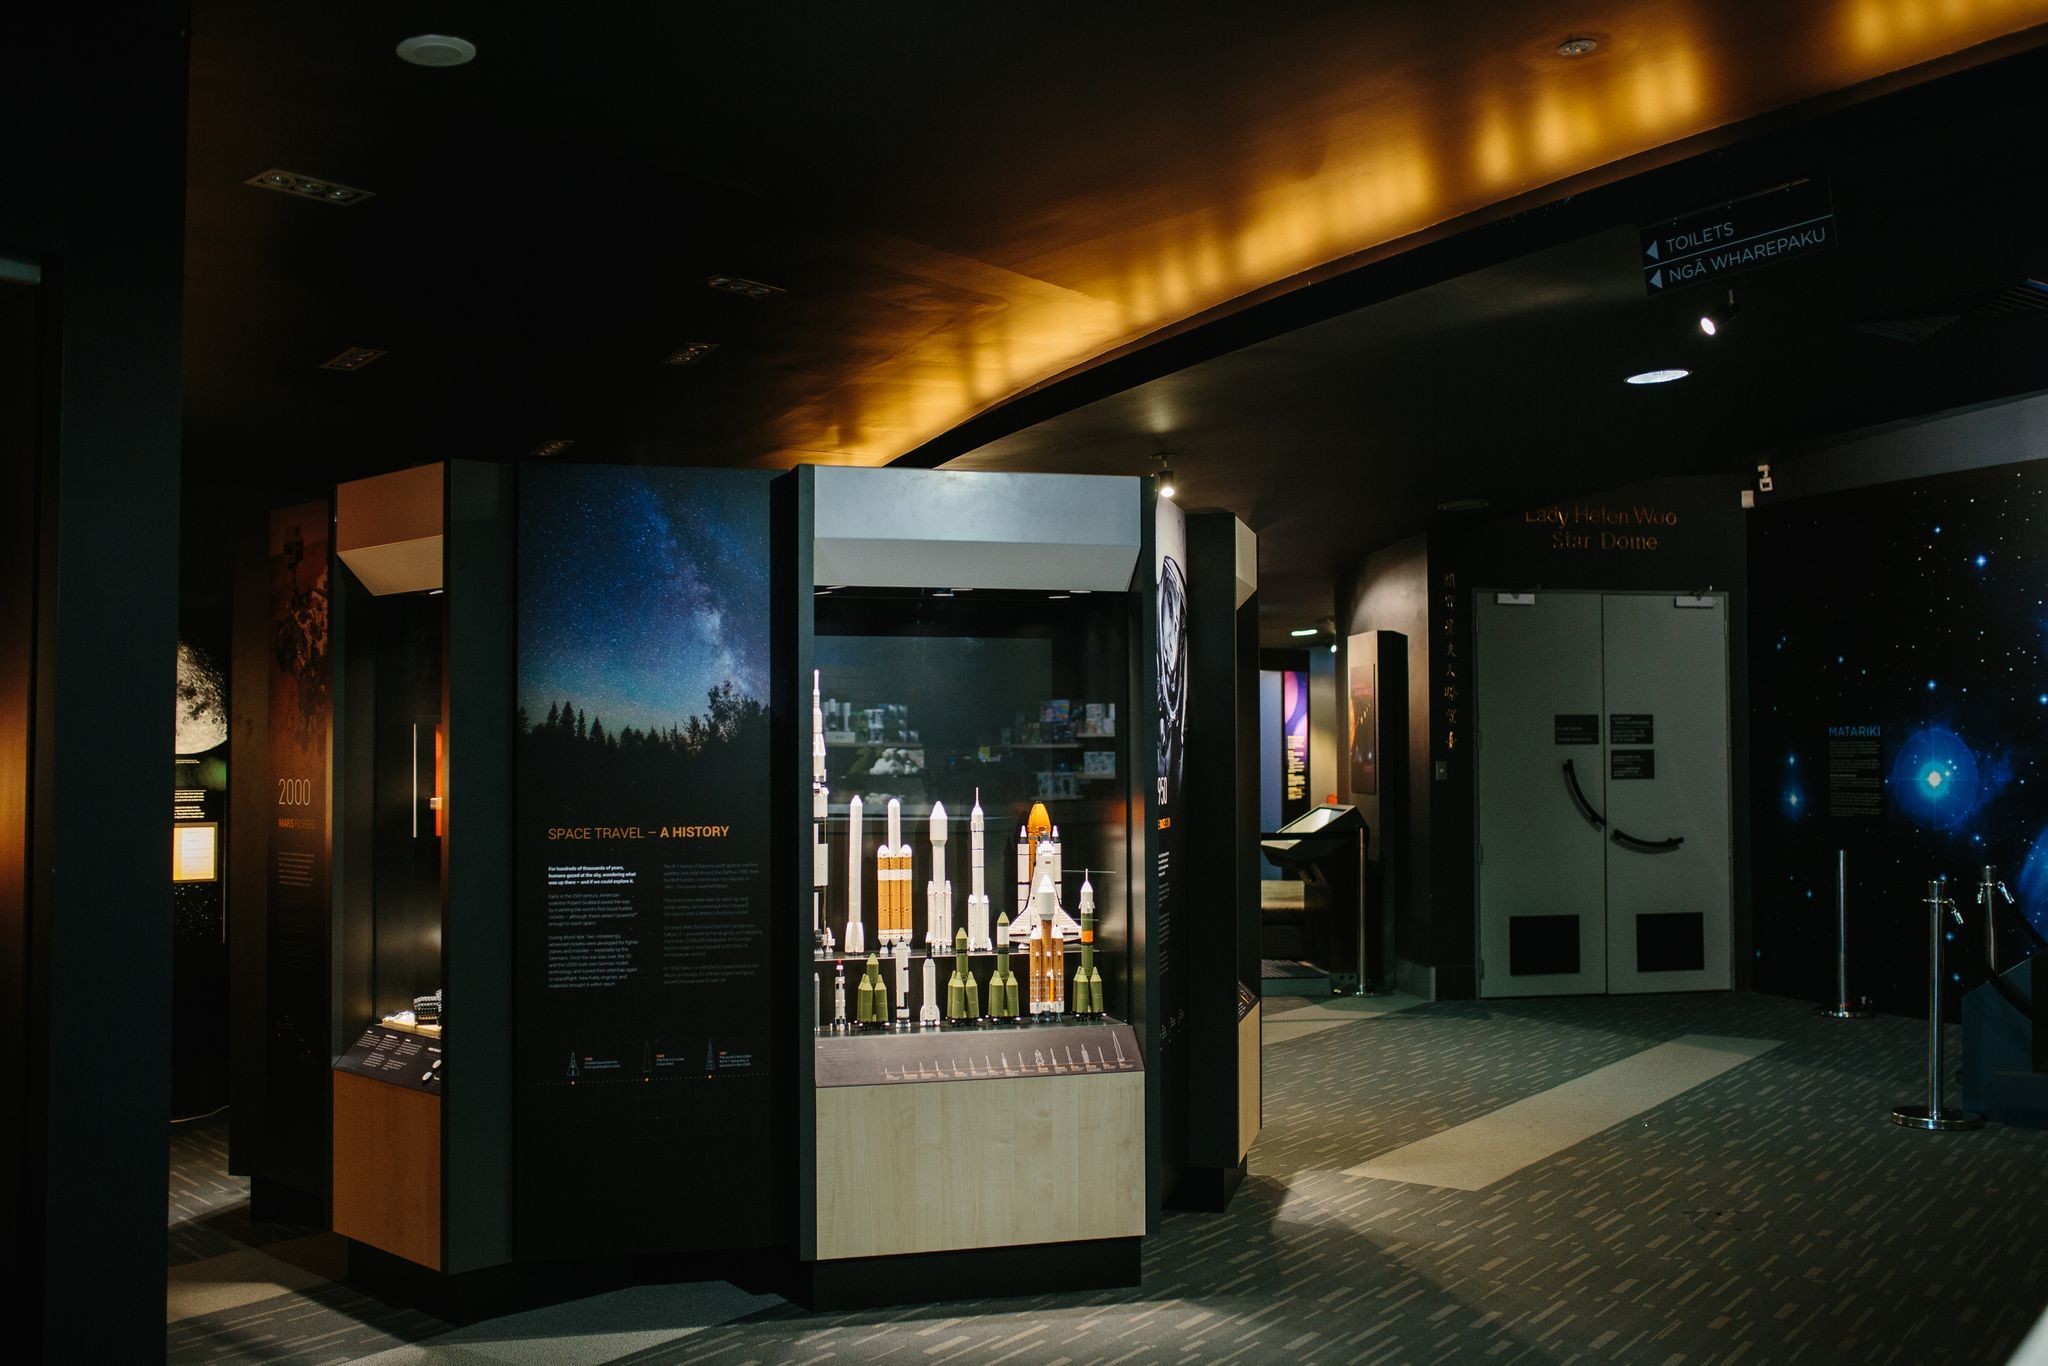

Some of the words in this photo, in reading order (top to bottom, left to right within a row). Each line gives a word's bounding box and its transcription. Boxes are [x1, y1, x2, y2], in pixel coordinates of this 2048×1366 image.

[1665, 222, 1734, 253] TOILETS
[1668, 258, 1707, 283] NGĀ
[1710, 226, 1826, 271] WHAREPAKU
[1525, 504, 1568, 529] Lady
[1574, 504, 1629, 525] Helen
[1632, 505, 1679, 526] Woo
[1552, 531, 1591, 550] Star
[1601, 532, 1658, 550] Dome
[1828, 725, 1881, 737] MATARIKI
[278, 778, 311, 806] 2000
[1156, 776, 1168, 806] 950
[547, 827, 592, 840] SPACE
[594, 826, 645, 840] TRAVEL
[659, 826, 670, 838] A
[672, 825, 730, 838] HISTORY
